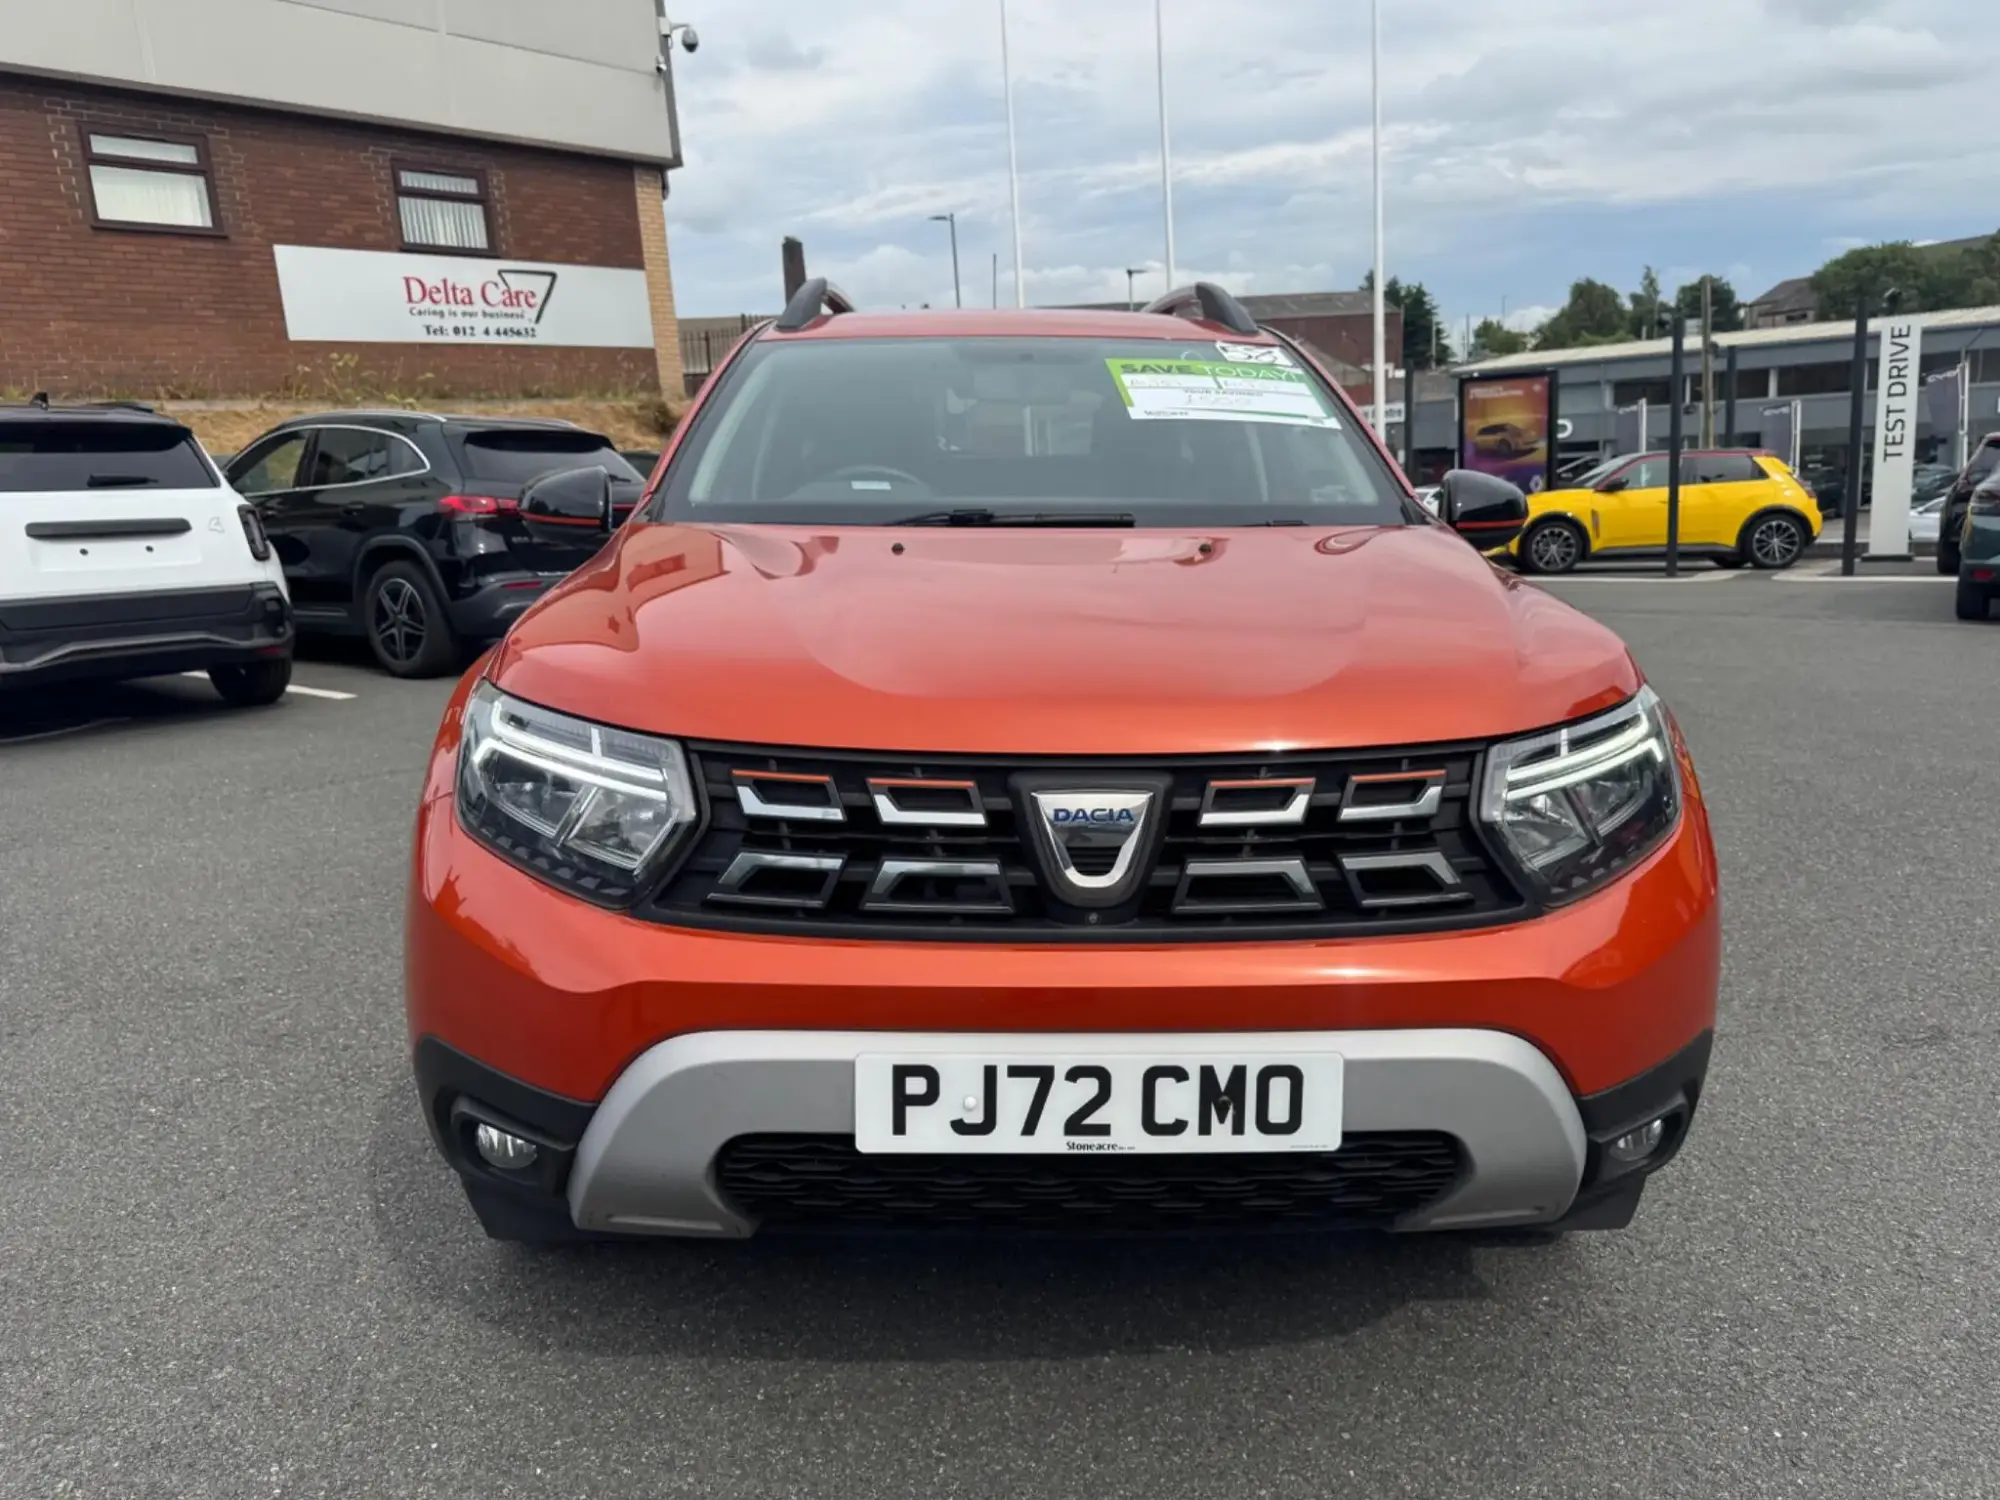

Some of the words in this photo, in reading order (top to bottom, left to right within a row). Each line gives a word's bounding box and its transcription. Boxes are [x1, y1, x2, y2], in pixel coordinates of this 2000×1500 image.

[402, 276, 474, 305] Delta
[480, 280, 538, 308] Care
[409, 307, 445, 319] Caring
[448, 308, 457, 317] is
[461, 310, 478, 318] our
[423, 325, 448, 336] Tel:
[1887, 324, 1911, 398] DRIVE
[1120, 363, 1196, 375] SAVE
[1883, 405, 1906, 463] TEST
[1053, 808, 1134, 822] DACIA
[892, 1064, 1112, 1137] PJ72
[1141, 1064, 1304, 1137] CMO
[1066, 1141, 1118, 1151] Stoneacre
